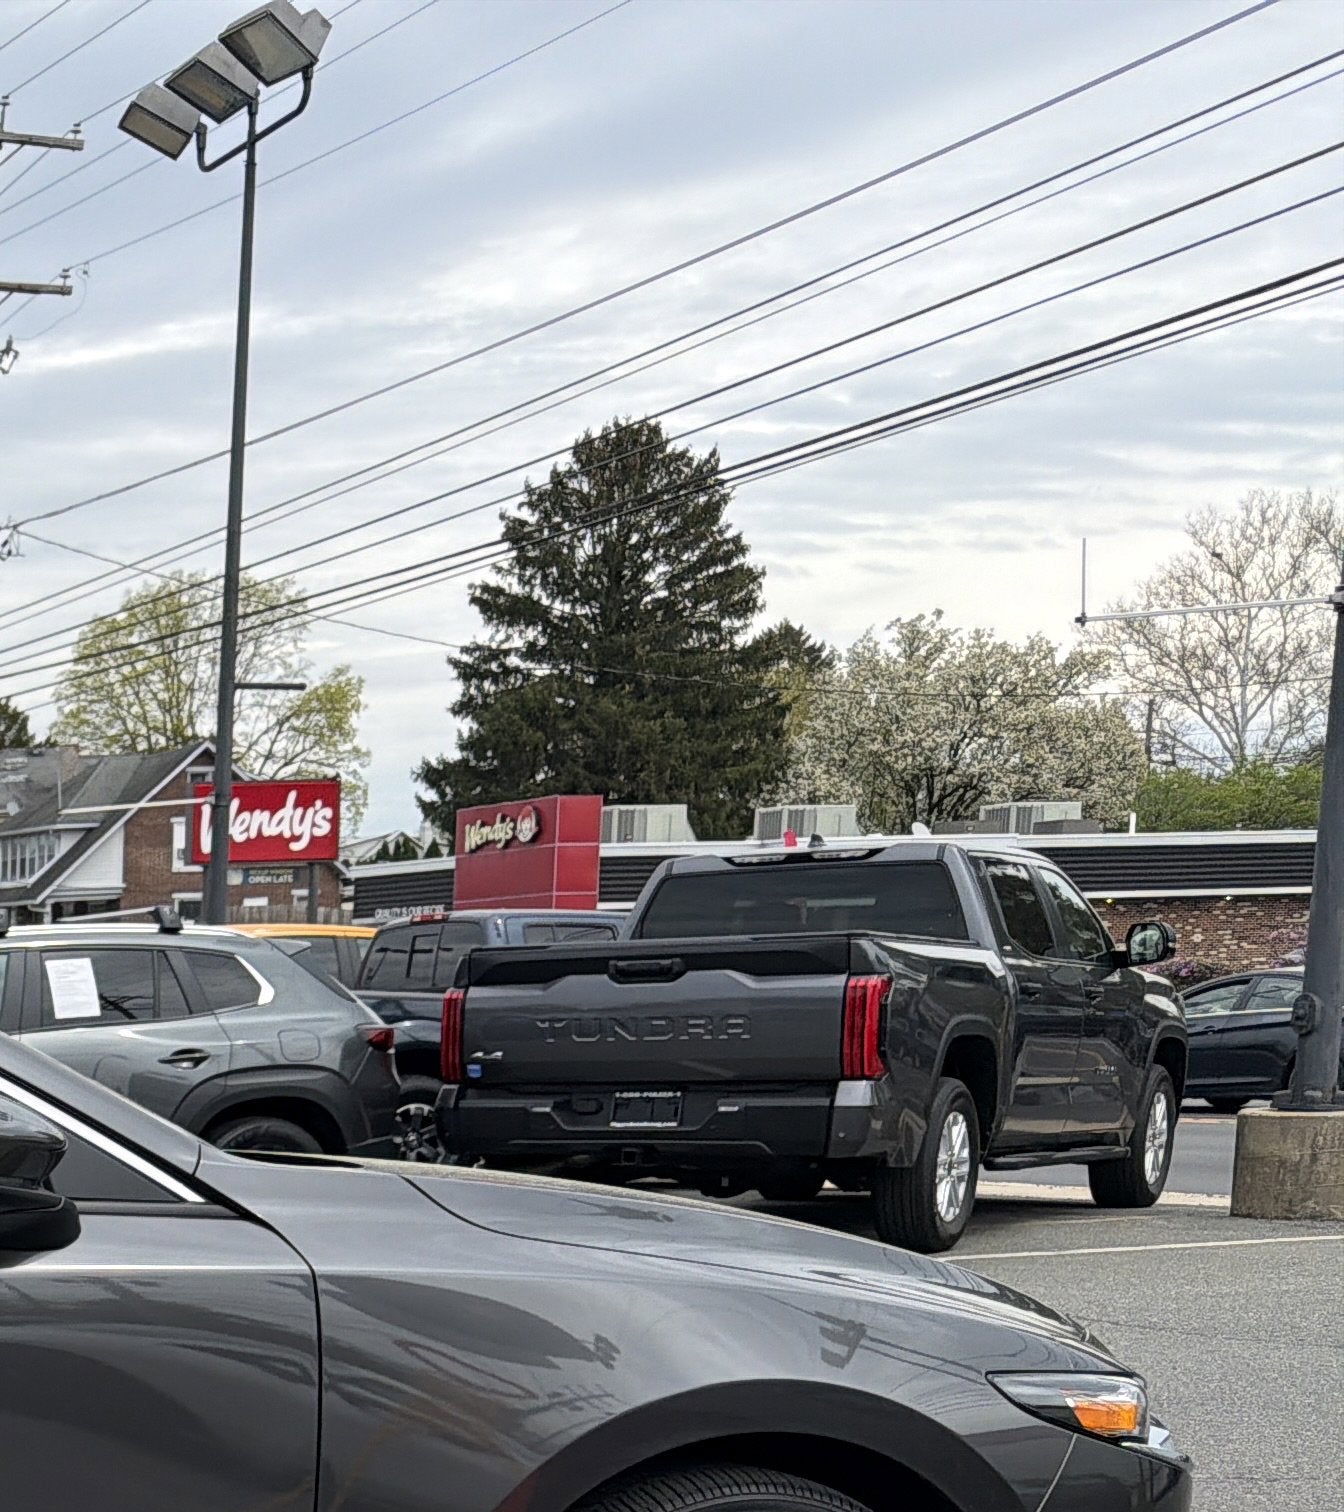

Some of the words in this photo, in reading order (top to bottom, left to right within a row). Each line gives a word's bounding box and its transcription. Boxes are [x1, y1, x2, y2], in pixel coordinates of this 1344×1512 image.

[464, 811, 515, 853] Wendy's
[248, 875, 272, 884] OPEN
[273, 875, 294, 884] LATE
[535, 1015, 752, 1042] TUNDRA
